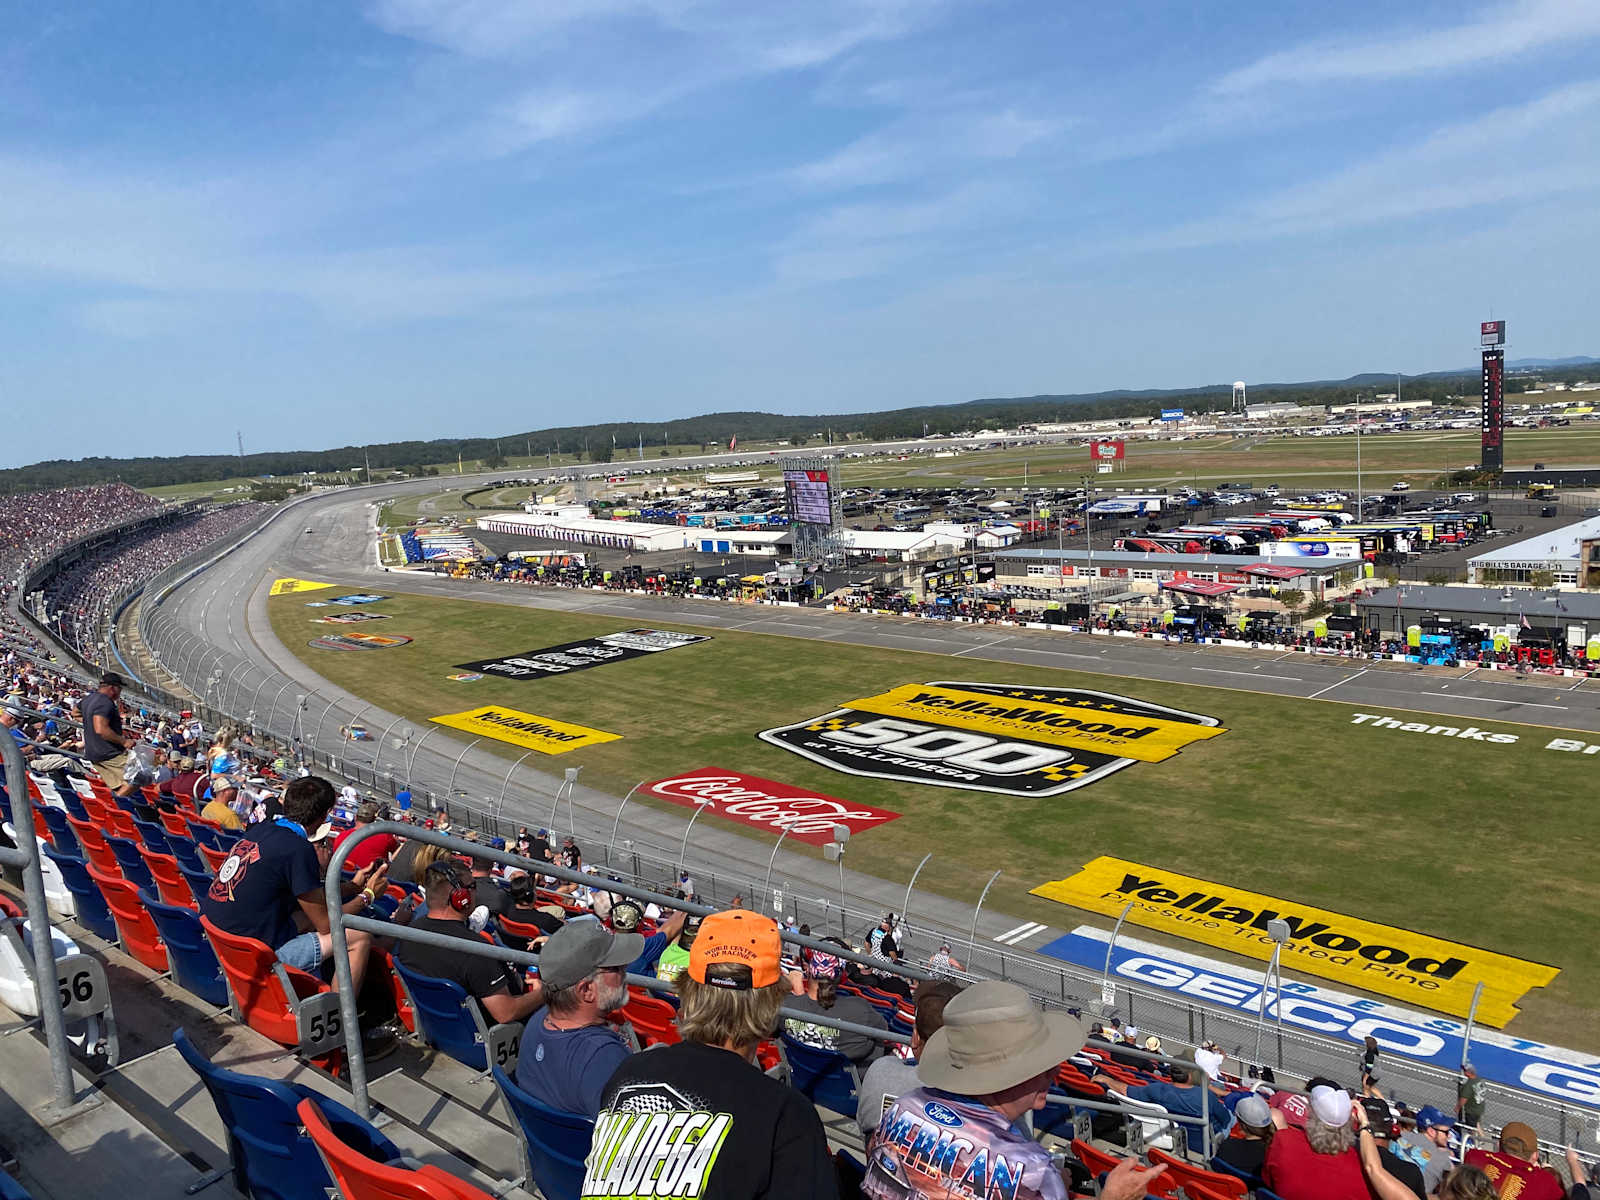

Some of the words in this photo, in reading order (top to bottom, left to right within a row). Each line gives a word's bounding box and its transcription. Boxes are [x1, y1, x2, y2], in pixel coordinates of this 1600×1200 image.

[1485, 561, 1510, 569] BILL'S
[1510, 562, 1544, 570] GARAGE
[474, 711, 588, 742] YellaWood
[895, 702, 979, 721] Pressure
[985, 715, 1066, 737] Treated
[1070, 732, 1128, 746] Pine
[905, 692, 1159, 740] YellaWood
[1352, 713, 1520, 744] Thanks
[803, 741, 828, 749] at
[829, 744, 984, 782] TALLADEGA
[819, 718, 1074, 777] 500
[652, 776, 888, 834] Coca-Cola
[1101, 892, 1221, 930] Pressure
[1233, 926, 1353, 968] Treated
[1363, 961, 1442, 991] Pine
[1117, 873, 1470, 981] YellaWood
[704, 944, 728, 956] WORLD
[730, 944, 758, 959] CENTER
[59, 971, 93, 1009] 56
[1115, 957, 1446, 1057] GEICO
[310, 1008, 340, 1043] 55
[496, 1036, 521, 1066] 54
[929, 1102, 957, 1125] Ford
